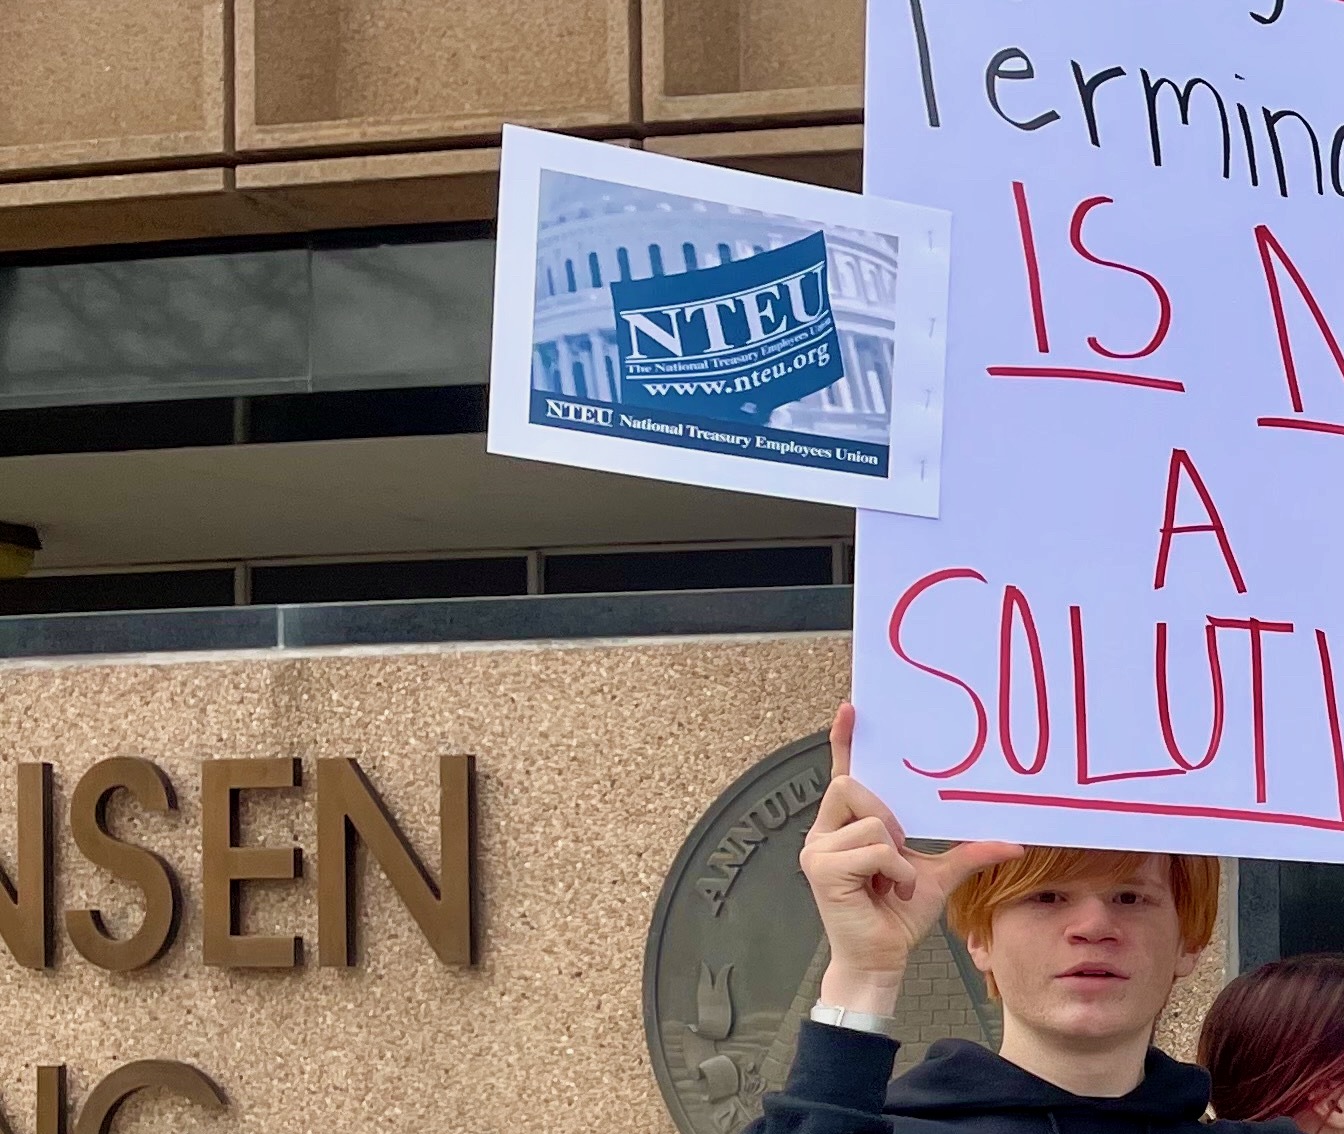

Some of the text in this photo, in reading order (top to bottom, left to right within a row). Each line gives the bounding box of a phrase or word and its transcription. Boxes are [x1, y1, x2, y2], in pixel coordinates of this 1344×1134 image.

[1012, 181, 1172, 360] IS
[620, 266, 827, 359] NTEU
[642, 342, 831, 396] www.nteu.org
[655, 358, 709, 374] National
[713, 348, 759, 369] Treasury
[545, 399, 879, 466] NTEU National Treasury Employees Union
[1154, 448, 1248, 594] A
